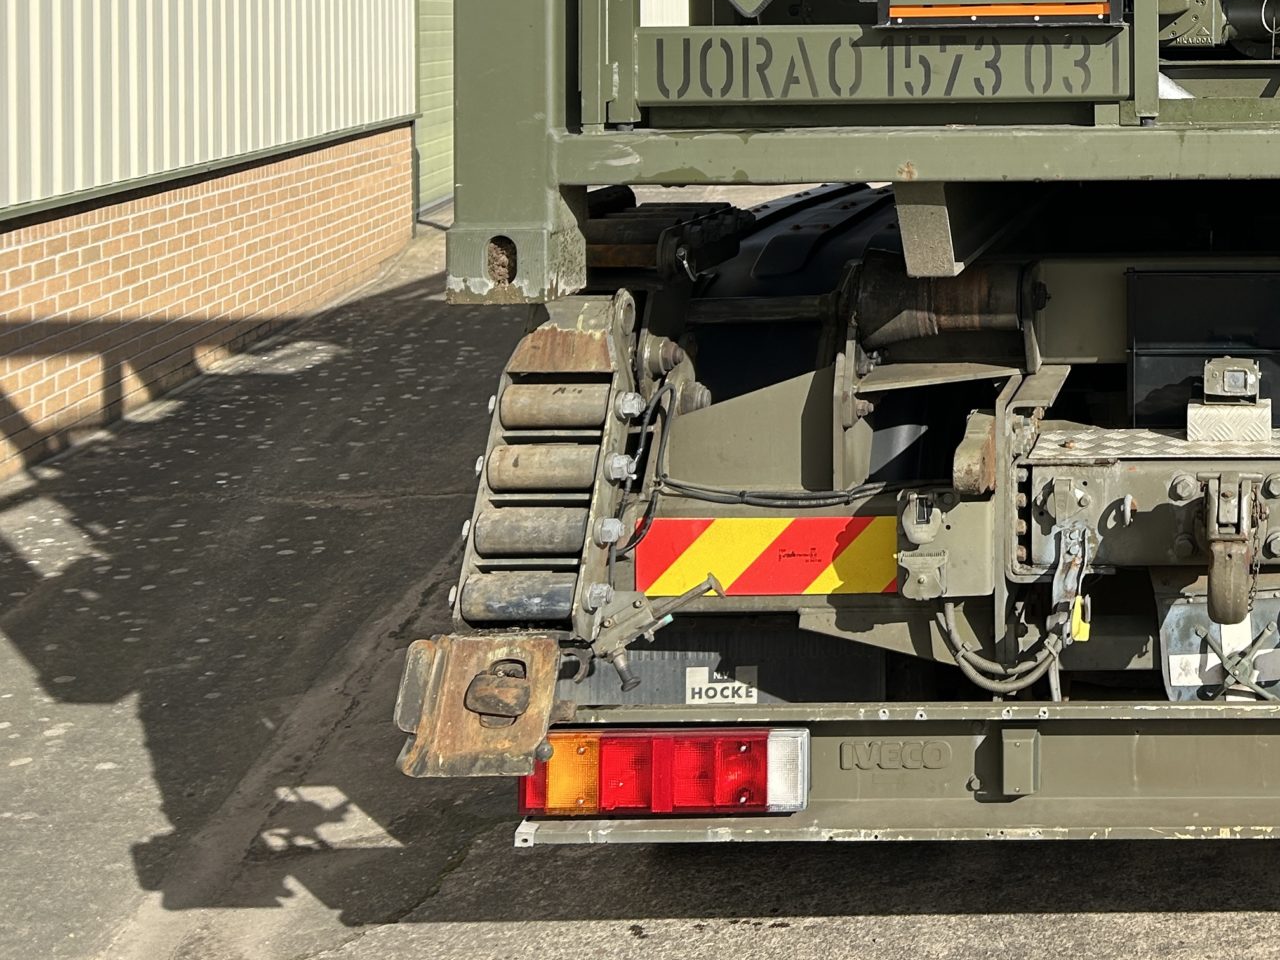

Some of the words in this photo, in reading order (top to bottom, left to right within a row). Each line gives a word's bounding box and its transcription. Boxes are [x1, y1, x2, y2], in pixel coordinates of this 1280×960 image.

[879, 35, 1002, 97] 1573
[1024, 34, 1120, 95] 031
[839, 740, 952, 770] IVECO
